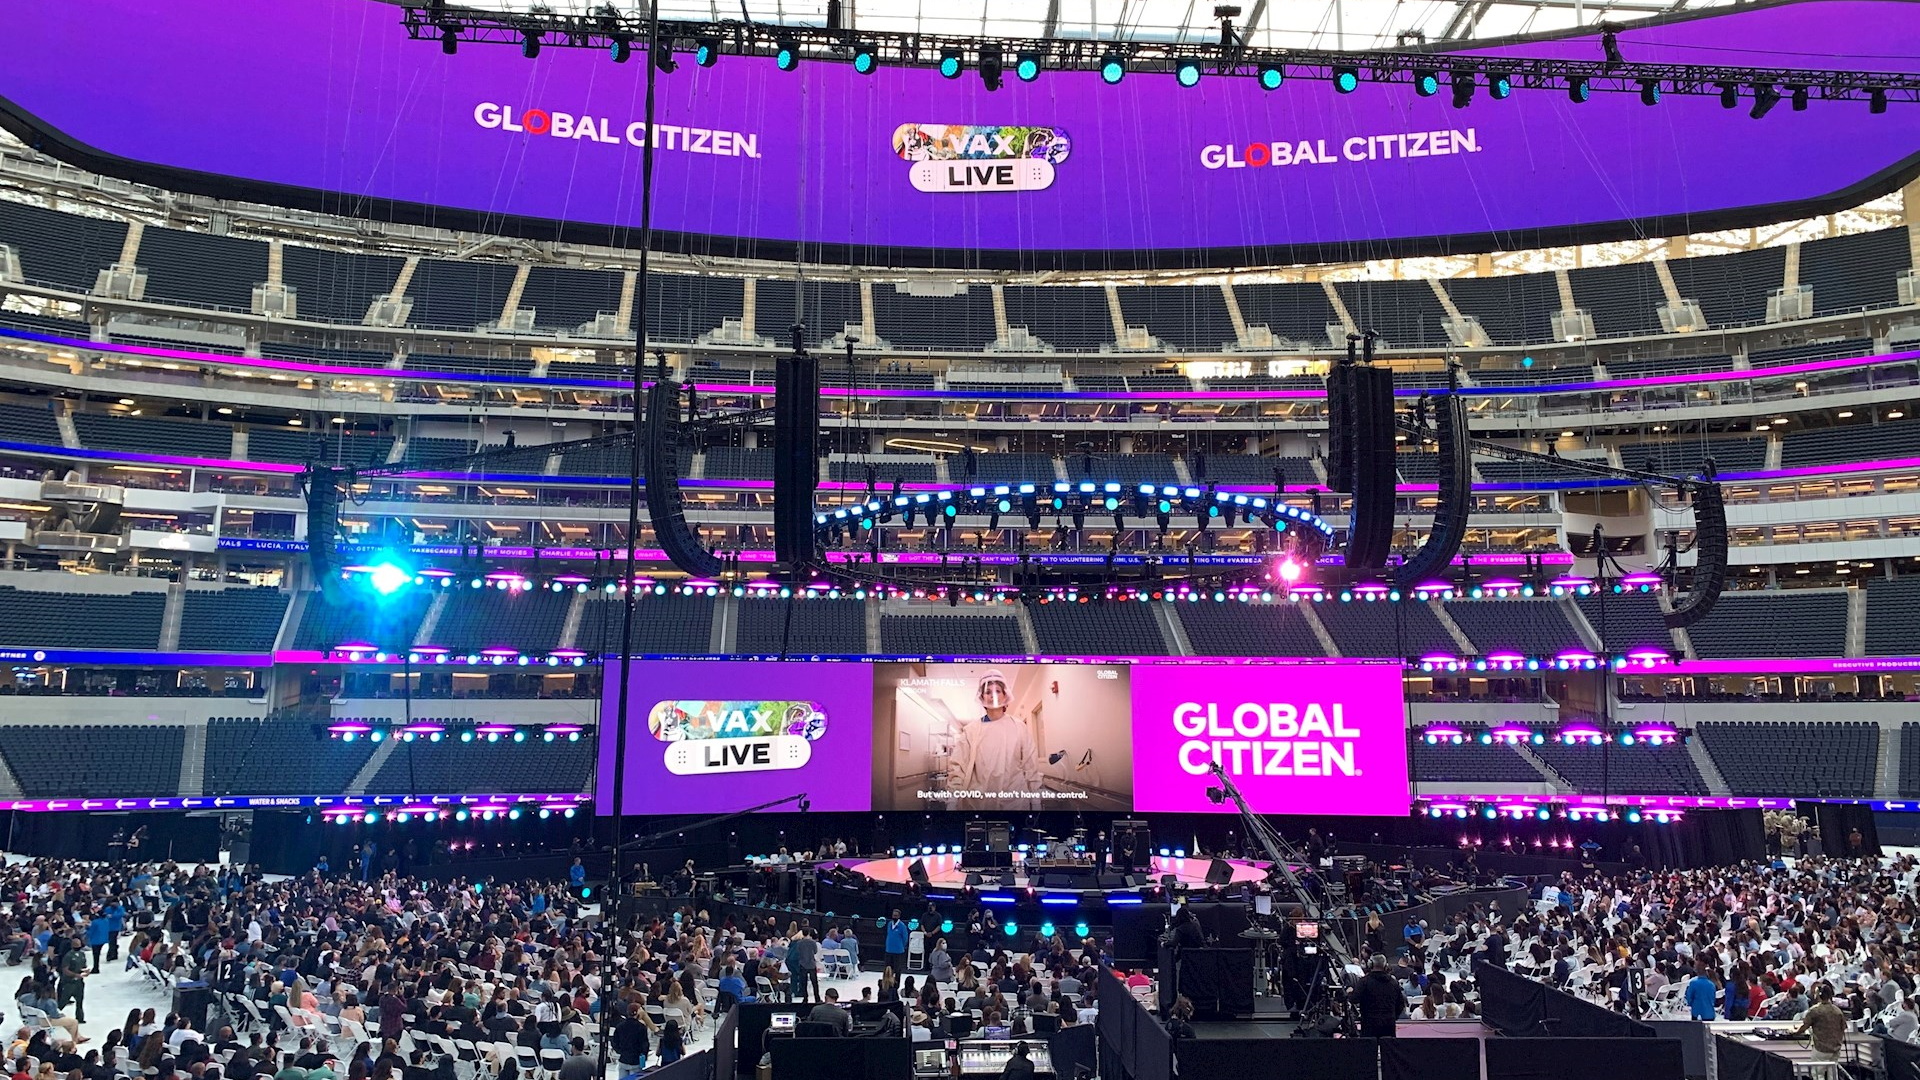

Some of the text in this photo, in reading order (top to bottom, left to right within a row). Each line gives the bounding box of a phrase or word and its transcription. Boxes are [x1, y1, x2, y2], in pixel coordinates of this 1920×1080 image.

[473, 102, 620, 144] GLOBAL
[949, 134, 1016, 155] VAX
[1200, 139, 1338, 170] GLOBAL
[949, 165, 1014, 186] LIVE
[256, 542, 284, 550] LUCIA,
[900, 679, 939, 687] KLAMATH
[706, 710, 773, 733] VAX
[1172, 702, 1361, 738] GLOBAL
[704, 743, 770, 768] LIVE
[249, 797, 270, 805] WATER
[917, 790, 932, 798] But
[933, 790, 952, 798] with
[953, 790, 984, 800] COVID,
[998, 790, 1020, 798] don't
[1020, 791, 1039, 799] have
[1041, 791, 1056, 799] the
[1056, 791, 1088, 799] control.
[1841, 871, 1846, 880] 5
[224, 963, 231, 979] 2
[1635, 972, 1642, 990] 3
